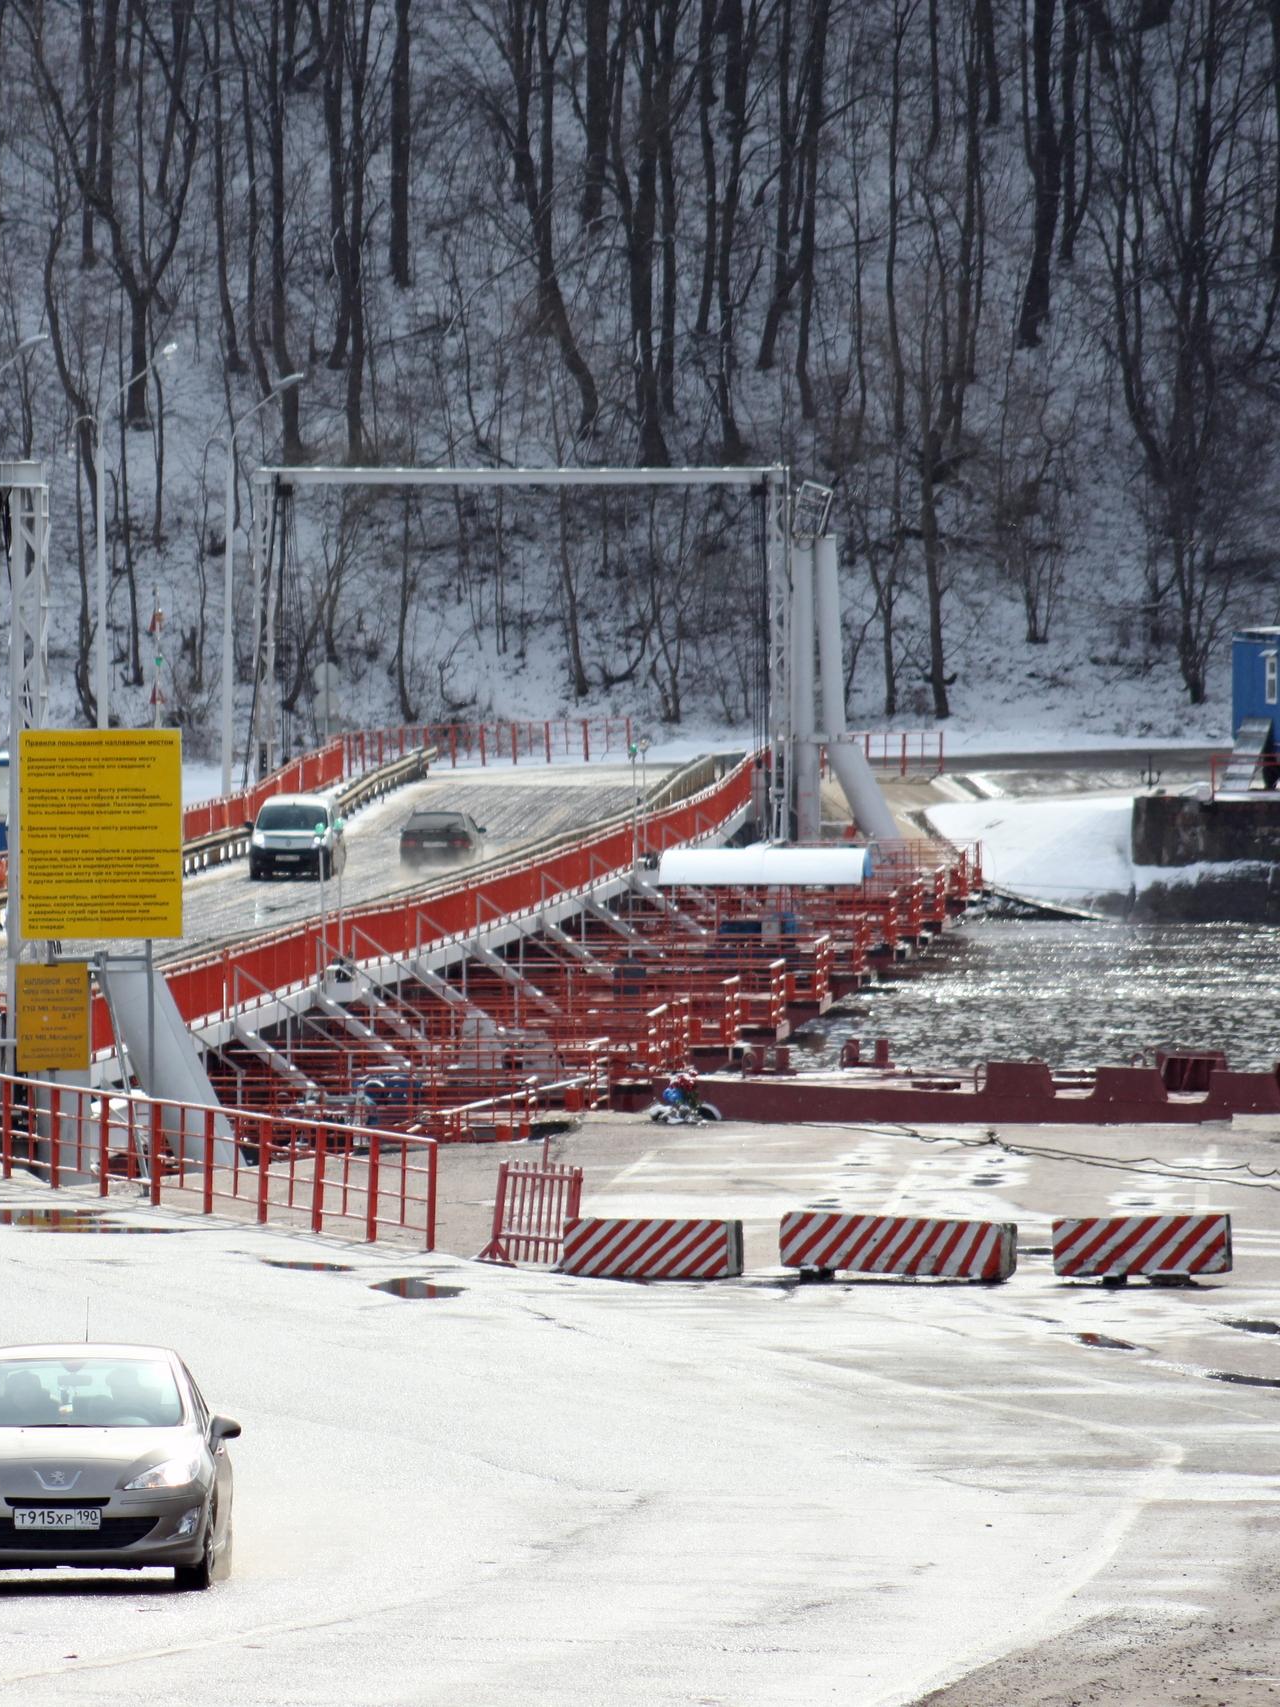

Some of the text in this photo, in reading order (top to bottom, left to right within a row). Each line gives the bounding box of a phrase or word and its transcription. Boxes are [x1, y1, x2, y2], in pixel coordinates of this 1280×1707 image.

[24, 739, 173, 749] Правила пользования наплавным мостом
[76, 1510, 97, 1521] 190
